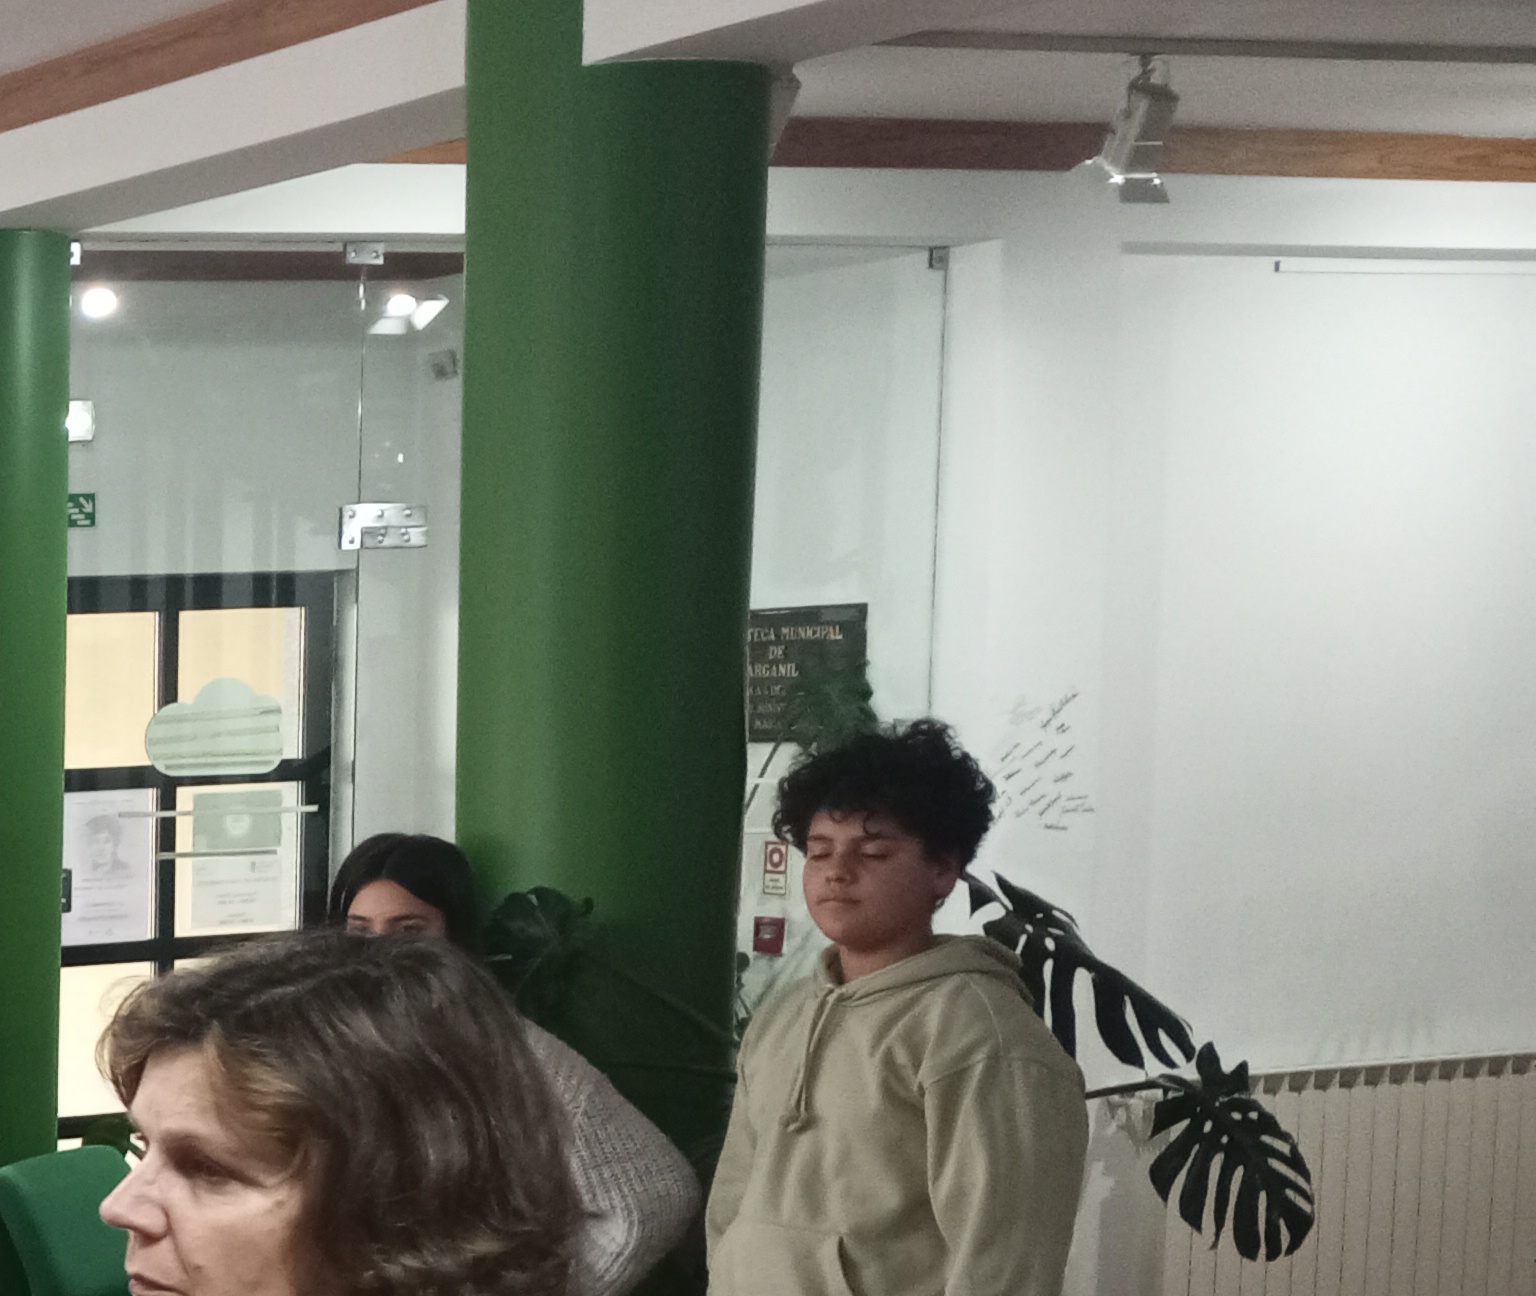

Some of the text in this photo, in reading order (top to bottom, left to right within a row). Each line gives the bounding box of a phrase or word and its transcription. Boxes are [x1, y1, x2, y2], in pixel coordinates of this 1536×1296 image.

[781, 625, 843, 641] MUNICIPAL
[769, 645, 786, 659] DE
[748, 663, 799, 677] ARGANIL
